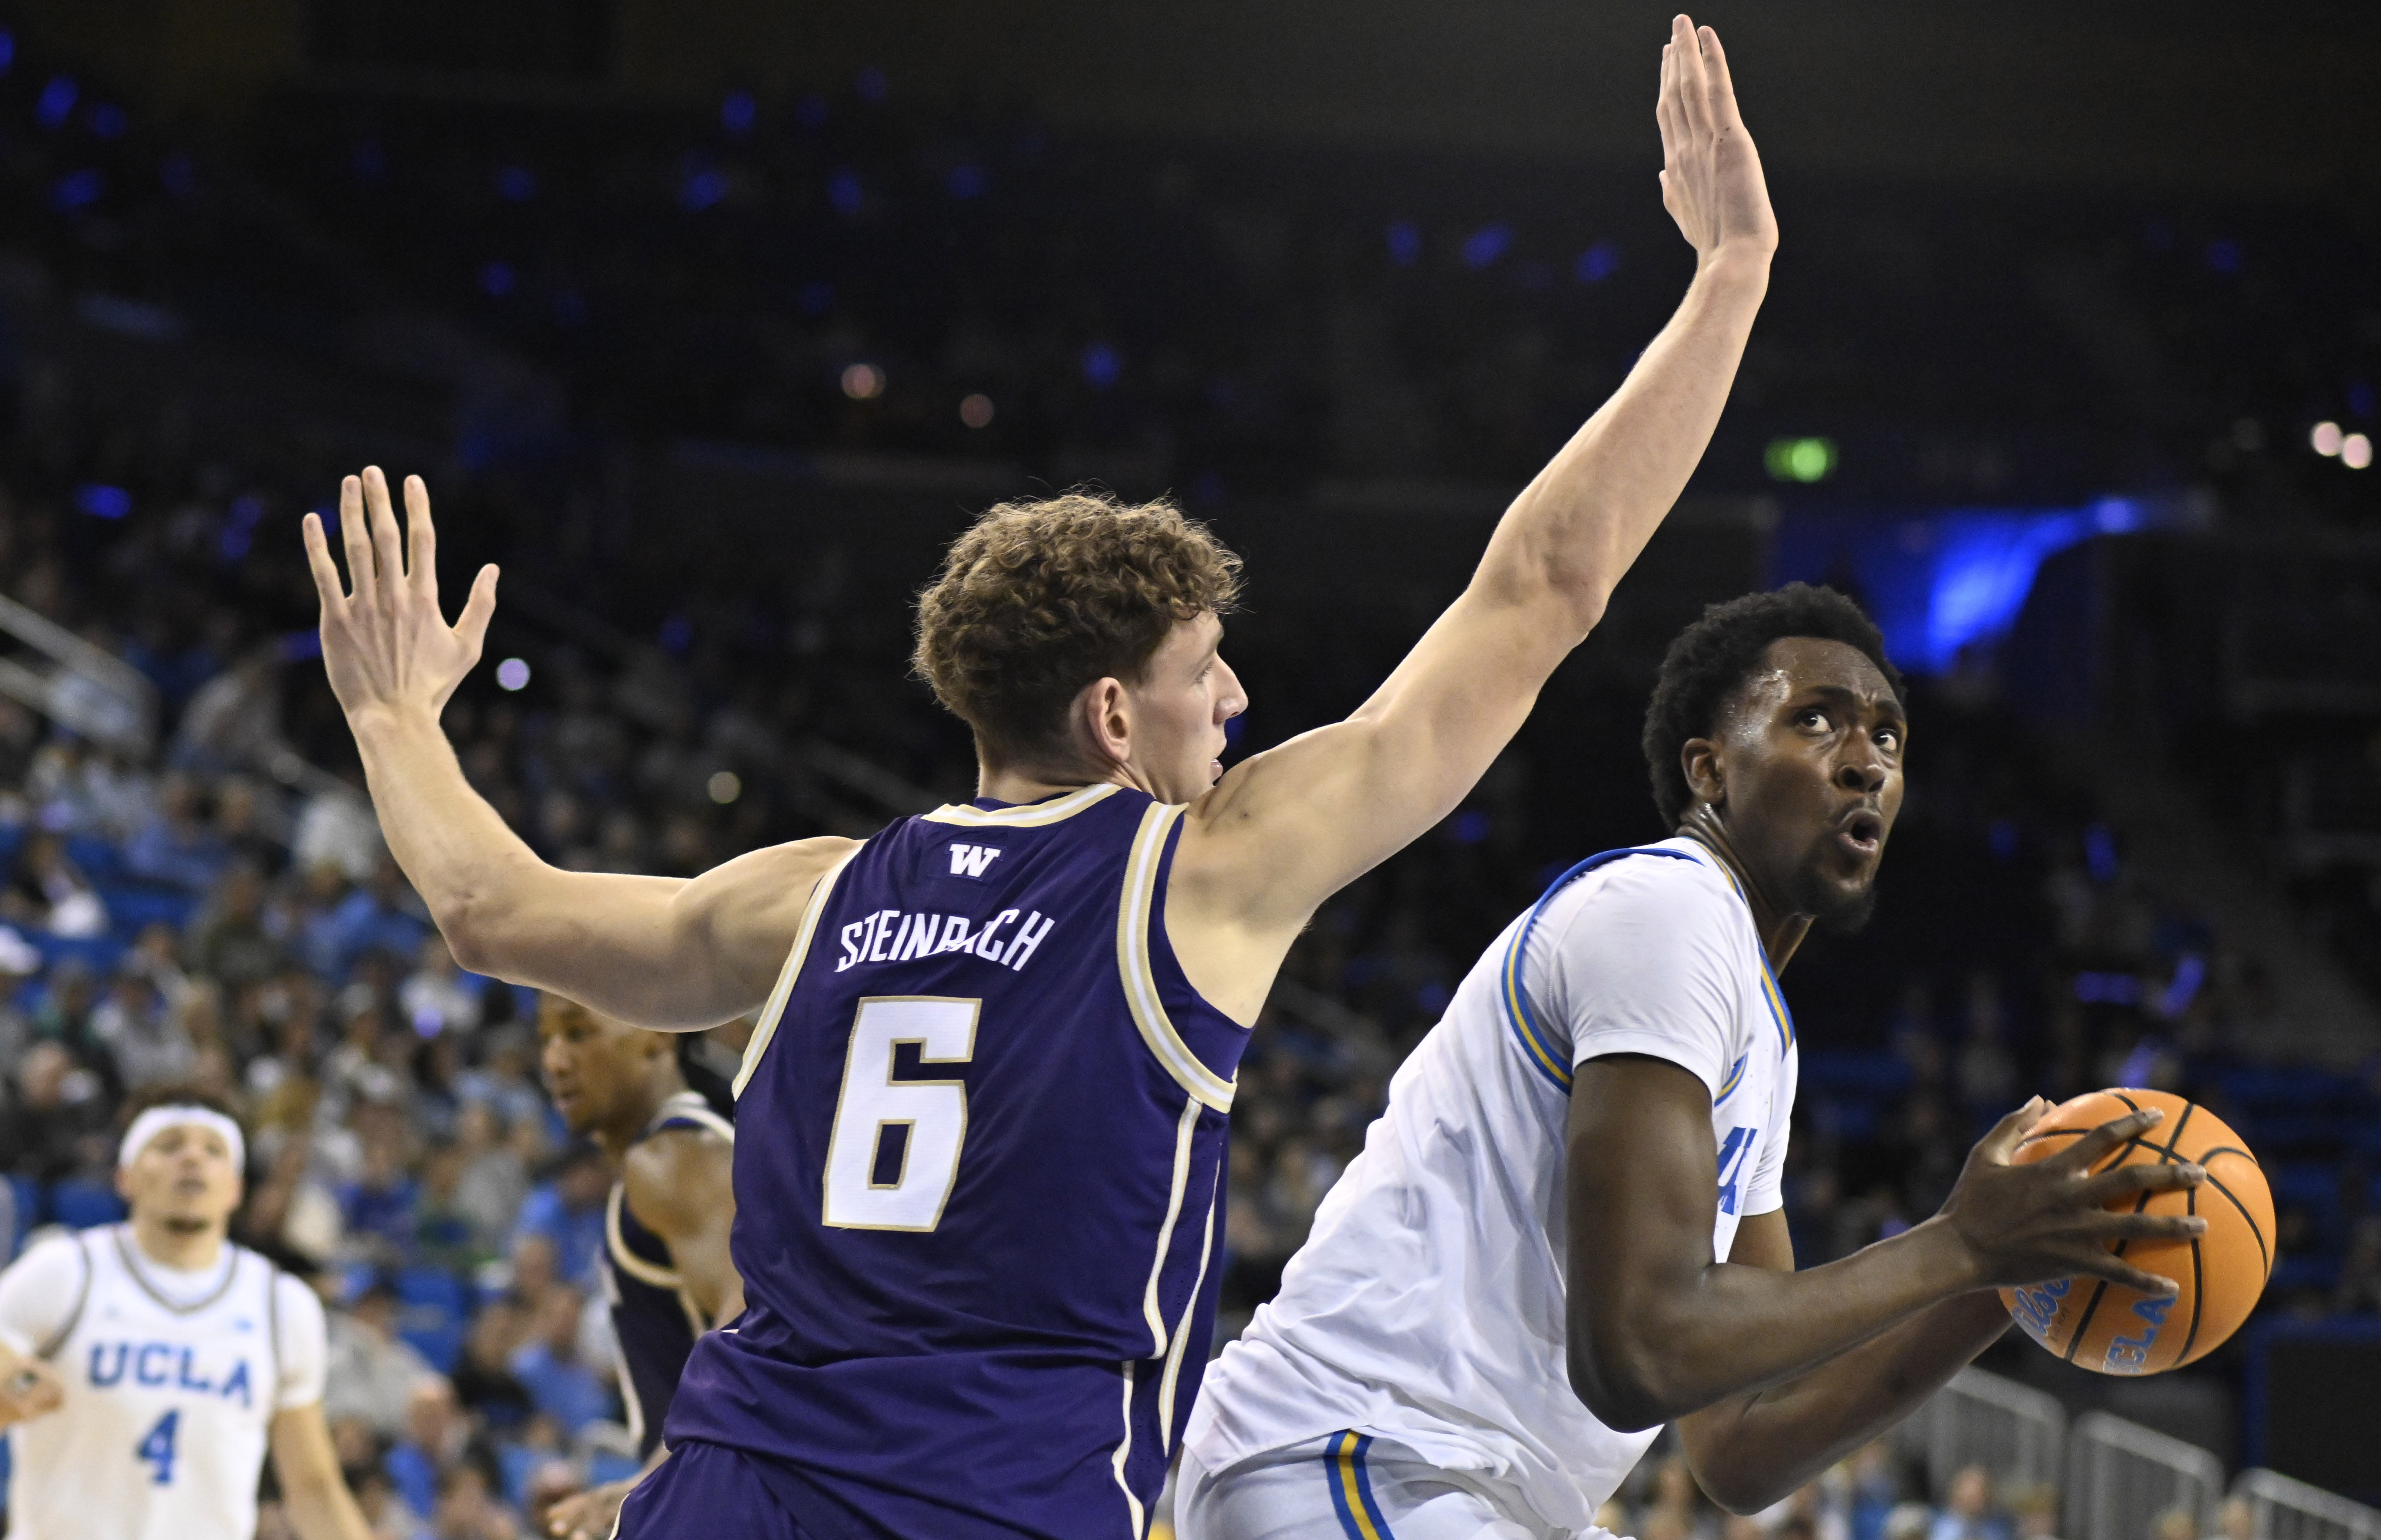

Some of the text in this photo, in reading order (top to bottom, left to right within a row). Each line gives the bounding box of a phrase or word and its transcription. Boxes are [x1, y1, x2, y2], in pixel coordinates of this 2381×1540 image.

[949, 844, 1001, 878] W
[822, 995, 983, 1232] 6
[89, 1344, 252, 1407] UCLA
[136, 1409, 179, 1485] 4
